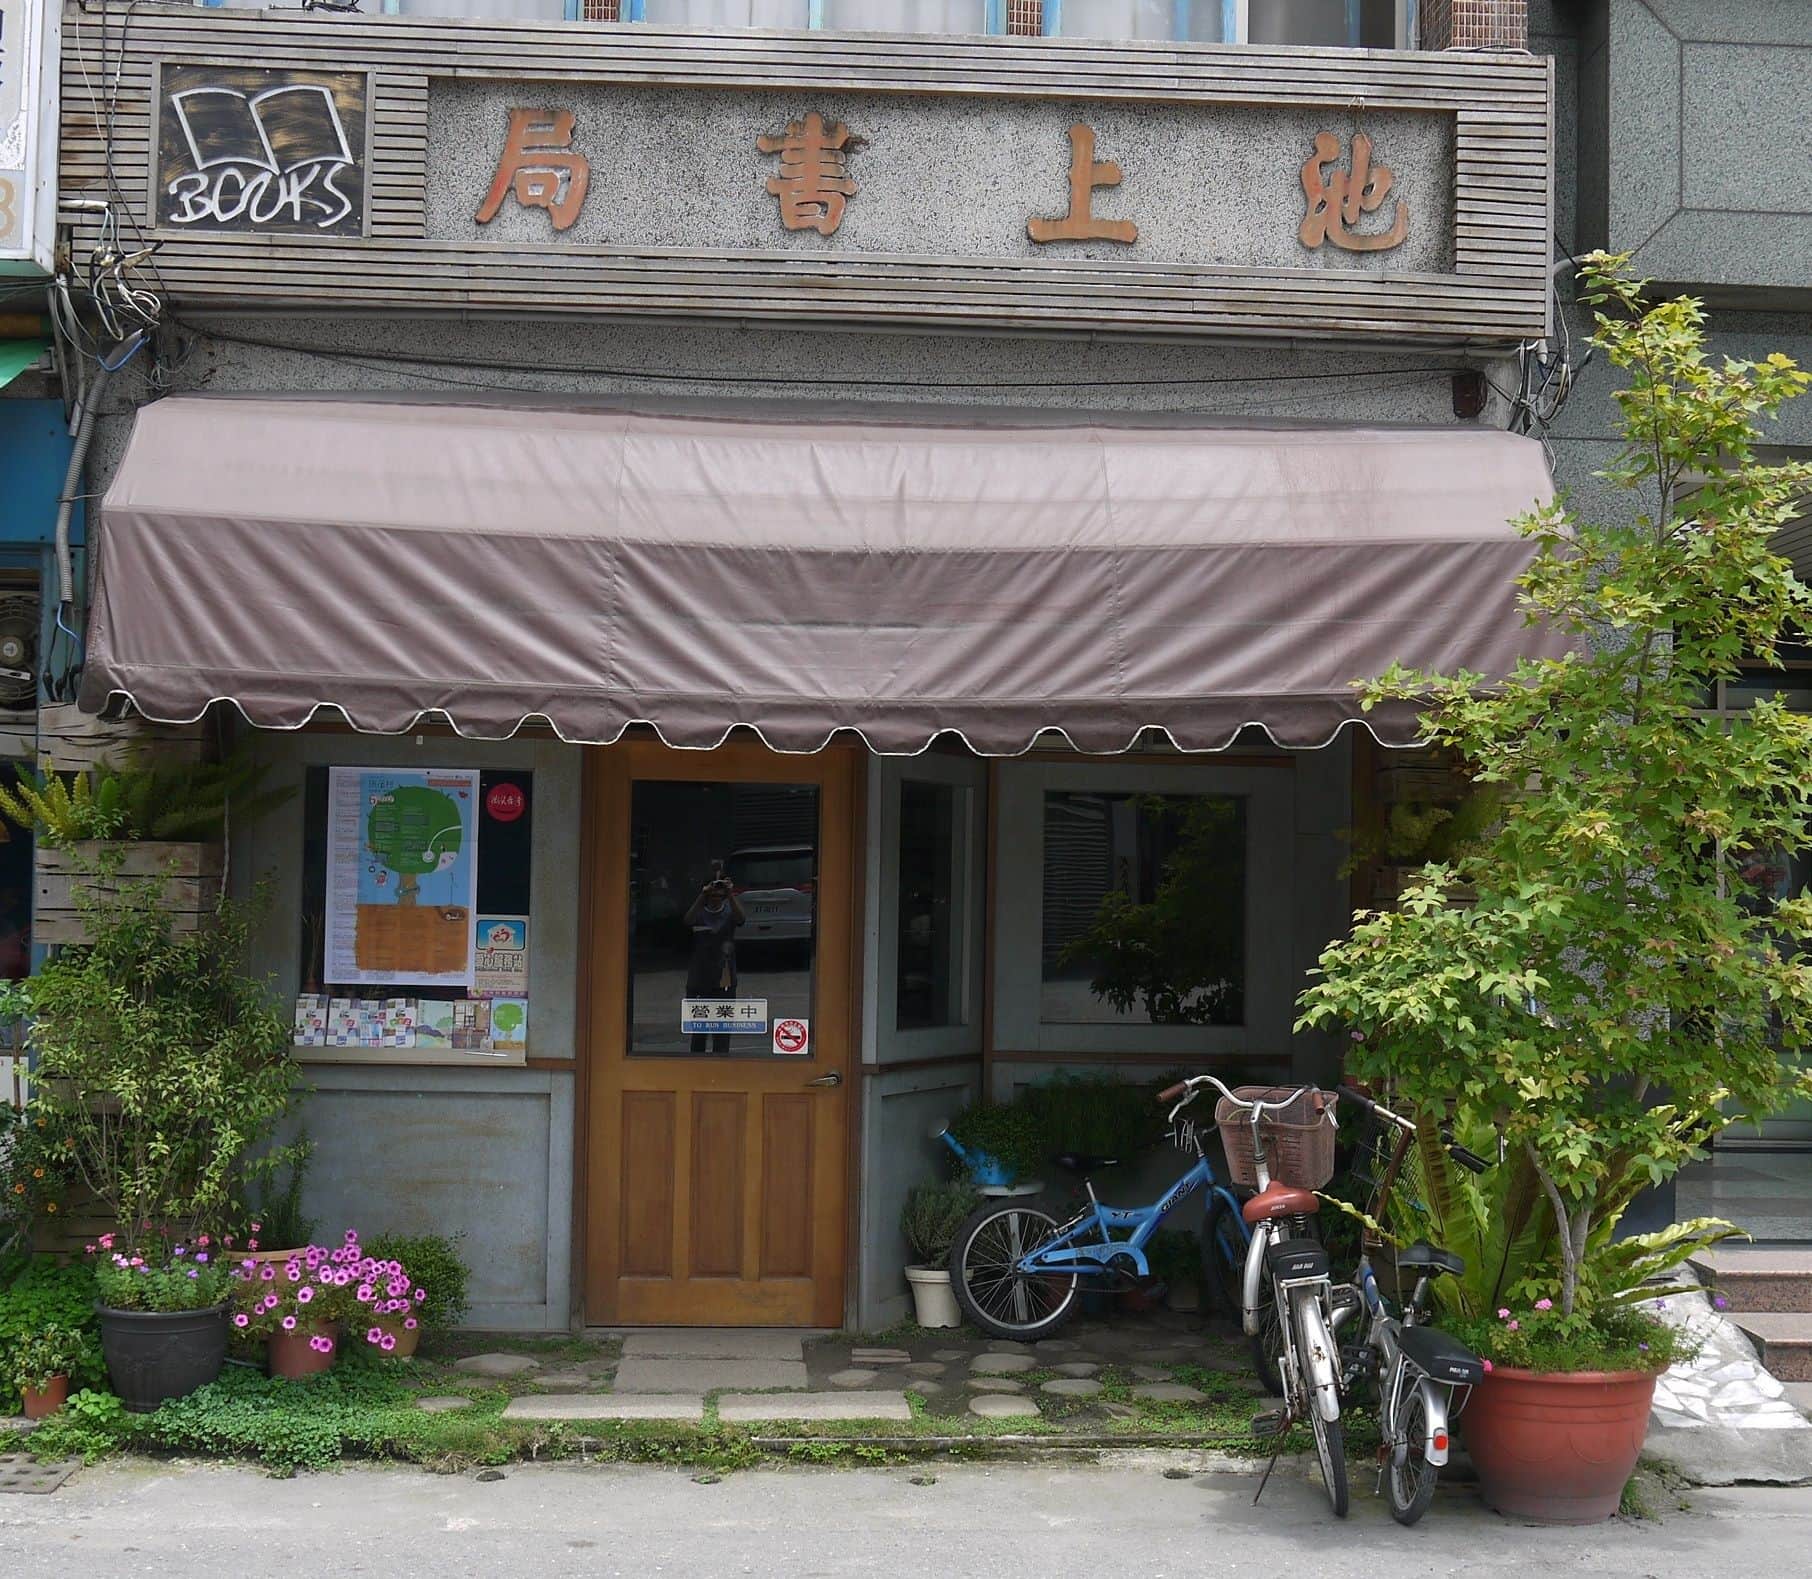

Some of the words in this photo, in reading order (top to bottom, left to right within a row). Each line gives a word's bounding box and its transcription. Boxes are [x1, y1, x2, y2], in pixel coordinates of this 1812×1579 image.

[168, 163, 353, 228] BOOKS
[691, 1004, 757, 1019] 營業中
[692, 1021, 703, 1029] TO
